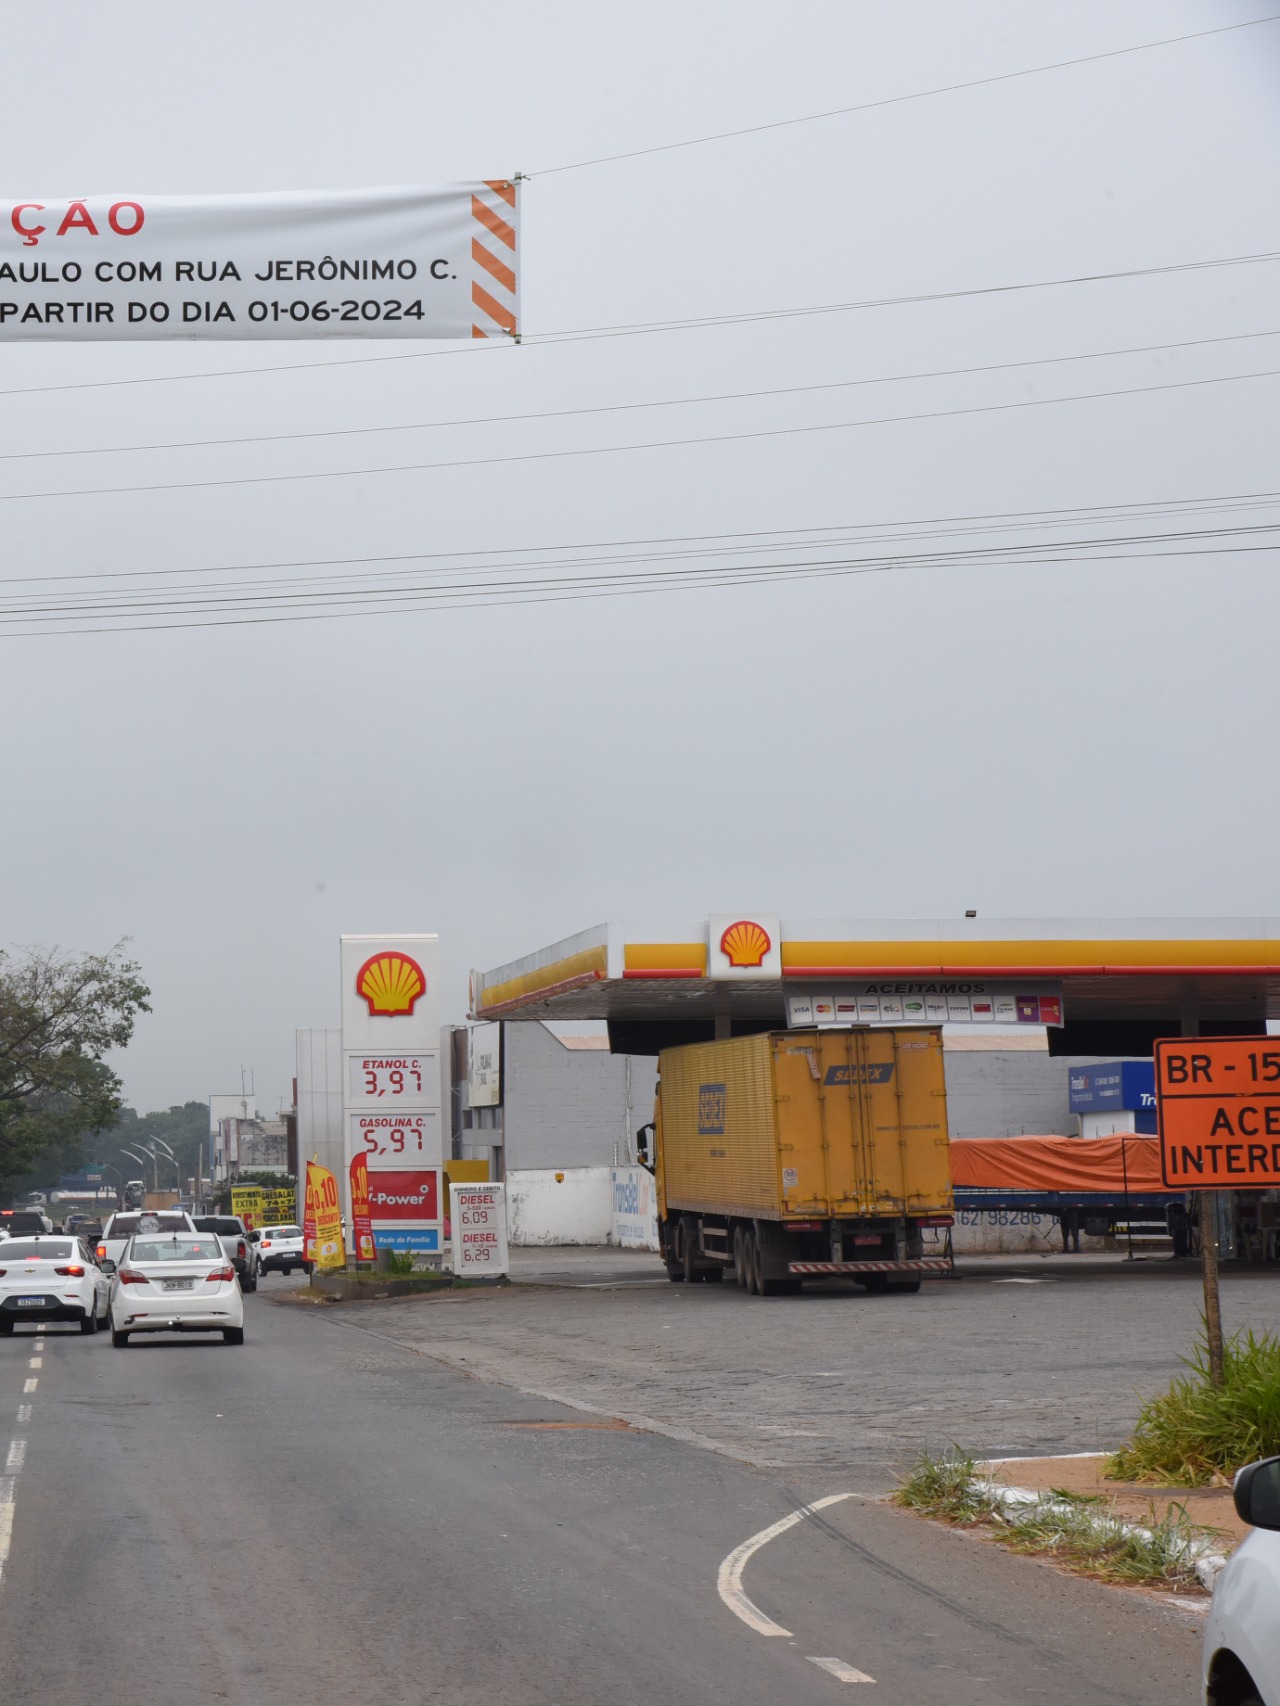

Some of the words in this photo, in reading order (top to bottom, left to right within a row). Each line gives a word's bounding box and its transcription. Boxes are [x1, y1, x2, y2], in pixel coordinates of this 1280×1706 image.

[95, 261, 163, 282] COM
[175, 261, 242, 281] RUA
[255, 255, 417, 281] JERÔNIMO
[430, 258, 458, 280] C.
[0, 302, 114, 323] PARTIR
[128, 302, 170, 323] DO
[182, 301, 236, 322] DIA
[247, 299, 426, 322] 01-06-2024
[865, 983, 986, 994] ACEITAMOS
[362, 1060, 409, 1069] ETANOL
[411, 1059, 421, 1069] C.
[1167, 1054, 1213, 1083] BR
[365, 1070, 422, 1097] 3,97
[359, 1118, 413, 1128] GASOLINA
[415, 1117, 426, 1127] C.
[1210, 1106, 1280, 1136] ACE
[363, 1128, 423, 1156] 5,97
[314, 1176, 337, 1215] 0,10
[460, 1195, 495, 1205] DIESEL
[236, 1200, 258, 1208] EXTRA
[462, 1211, 488, 1225] 6,09
[463, 1233, 497, 1243] DIESEL
[464, 1249, 490, 1262] 6,29
